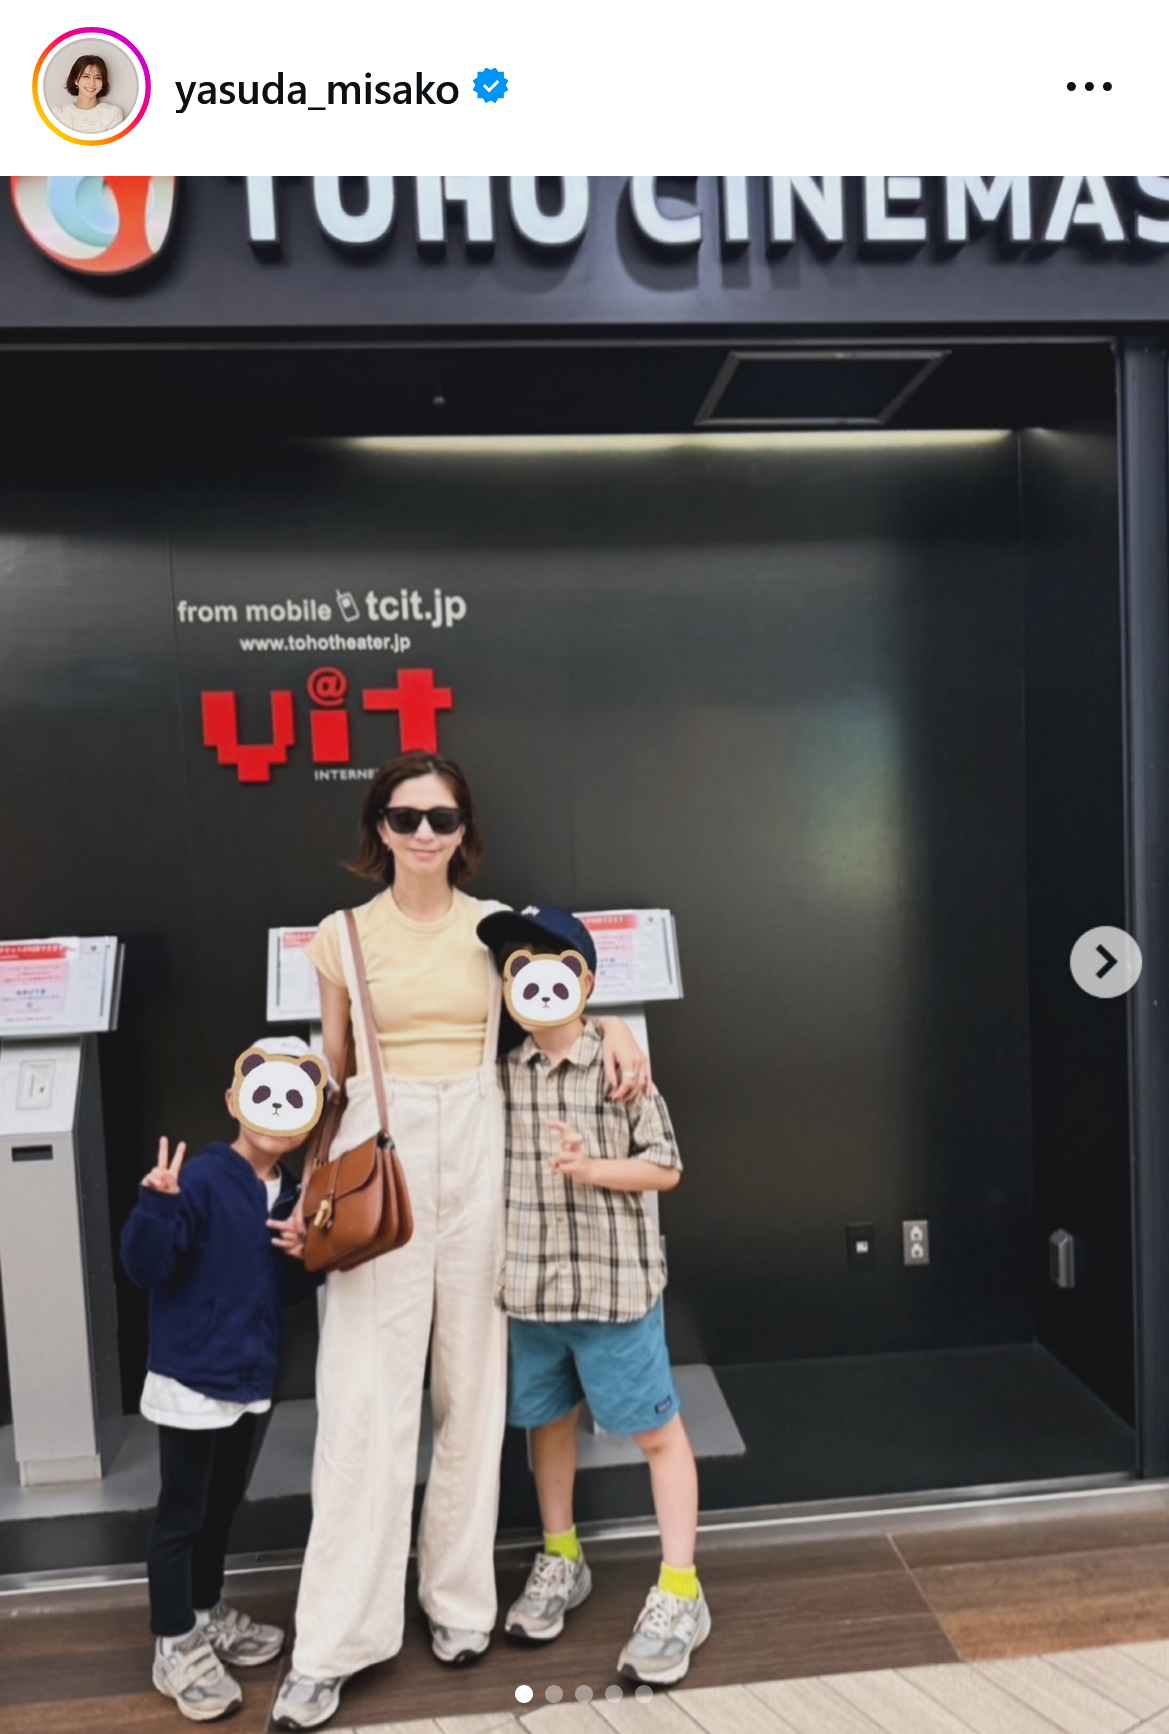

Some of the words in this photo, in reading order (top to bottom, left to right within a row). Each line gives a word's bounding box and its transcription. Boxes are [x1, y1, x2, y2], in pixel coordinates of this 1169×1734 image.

[177, 599, 238, 622] from
[246, 598, 332, 621] mobile
[365, 588, 467, 628] tcit.jp
[240, 633, 411, 653] www.tohotheater.jp
[314, 767, 380, 781] INTERNE
